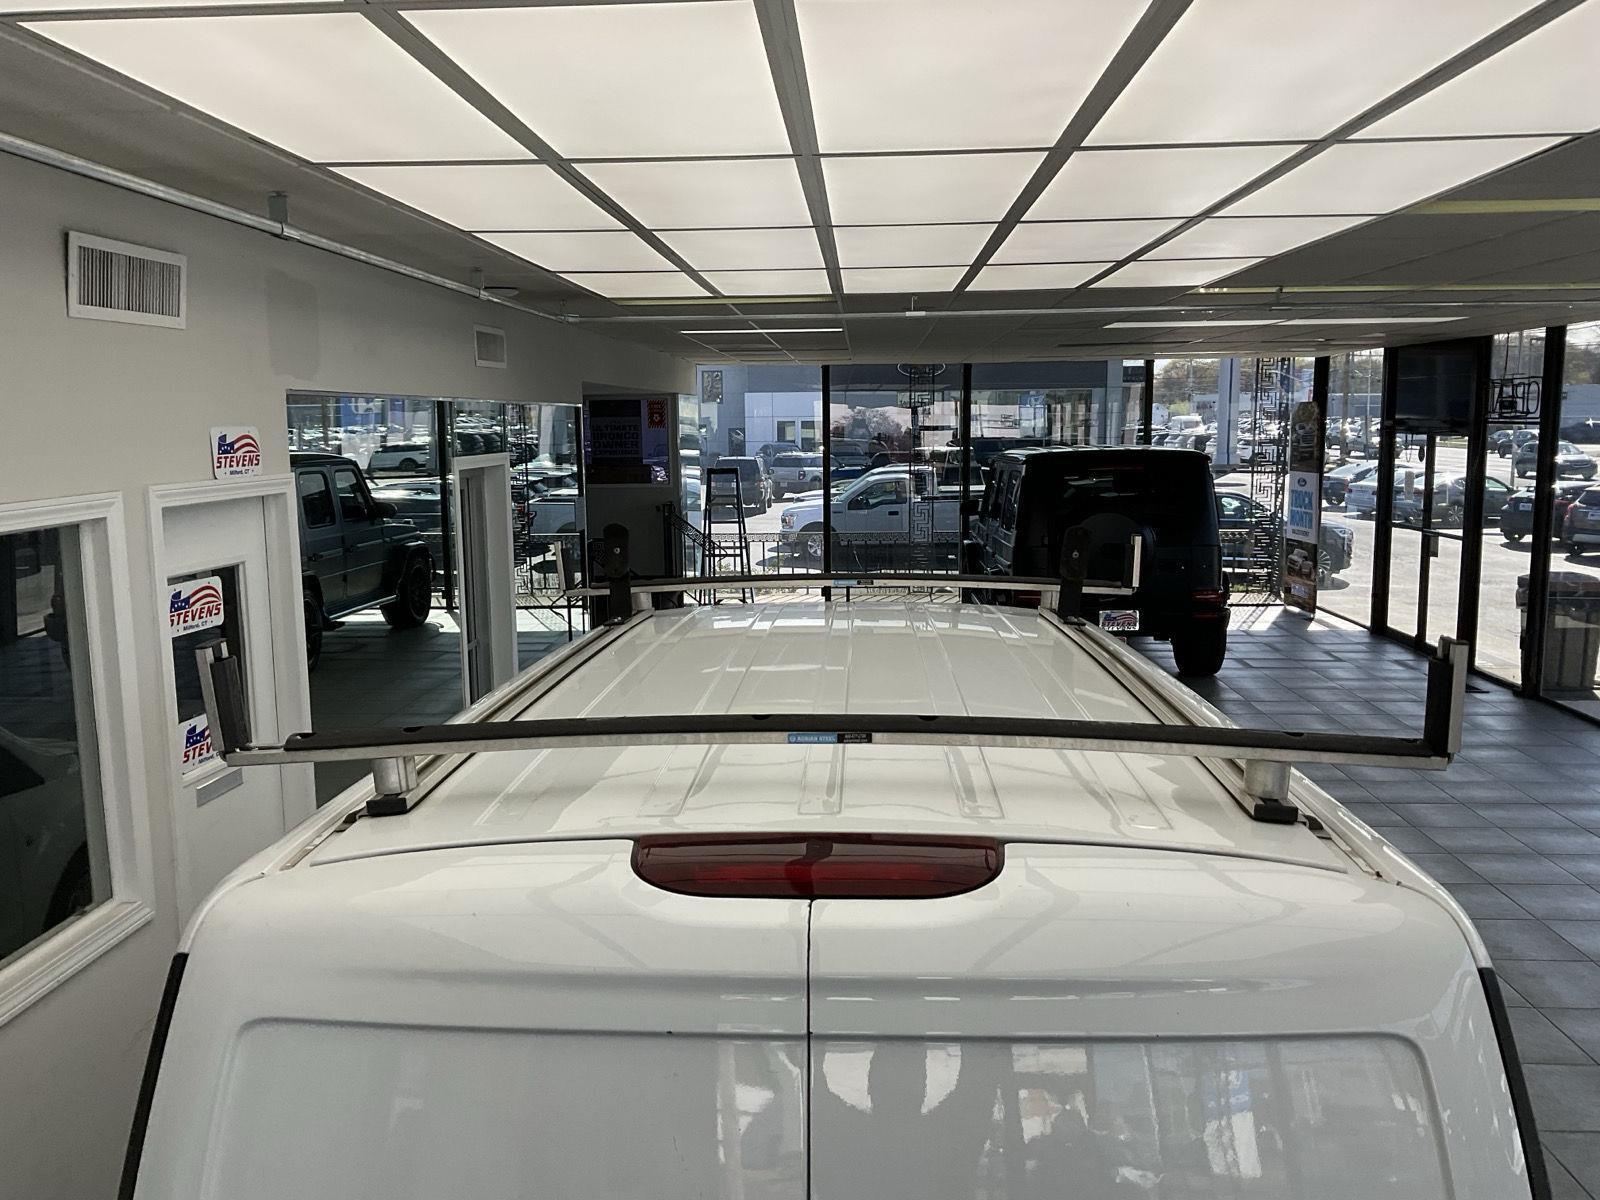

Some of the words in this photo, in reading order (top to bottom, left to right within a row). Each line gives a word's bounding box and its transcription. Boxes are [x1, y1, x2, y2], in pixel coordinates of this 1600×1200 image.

[592, 432, 639, 441] BRONCO
[593, 441, 638, 449] OWNER
[216, 454, 260, 469] STEVENS
[1290, 509, 1313, 529] MONTH
[169, 603, 222, 627] STEVENS
[183, 740, 212, 764] STEV
